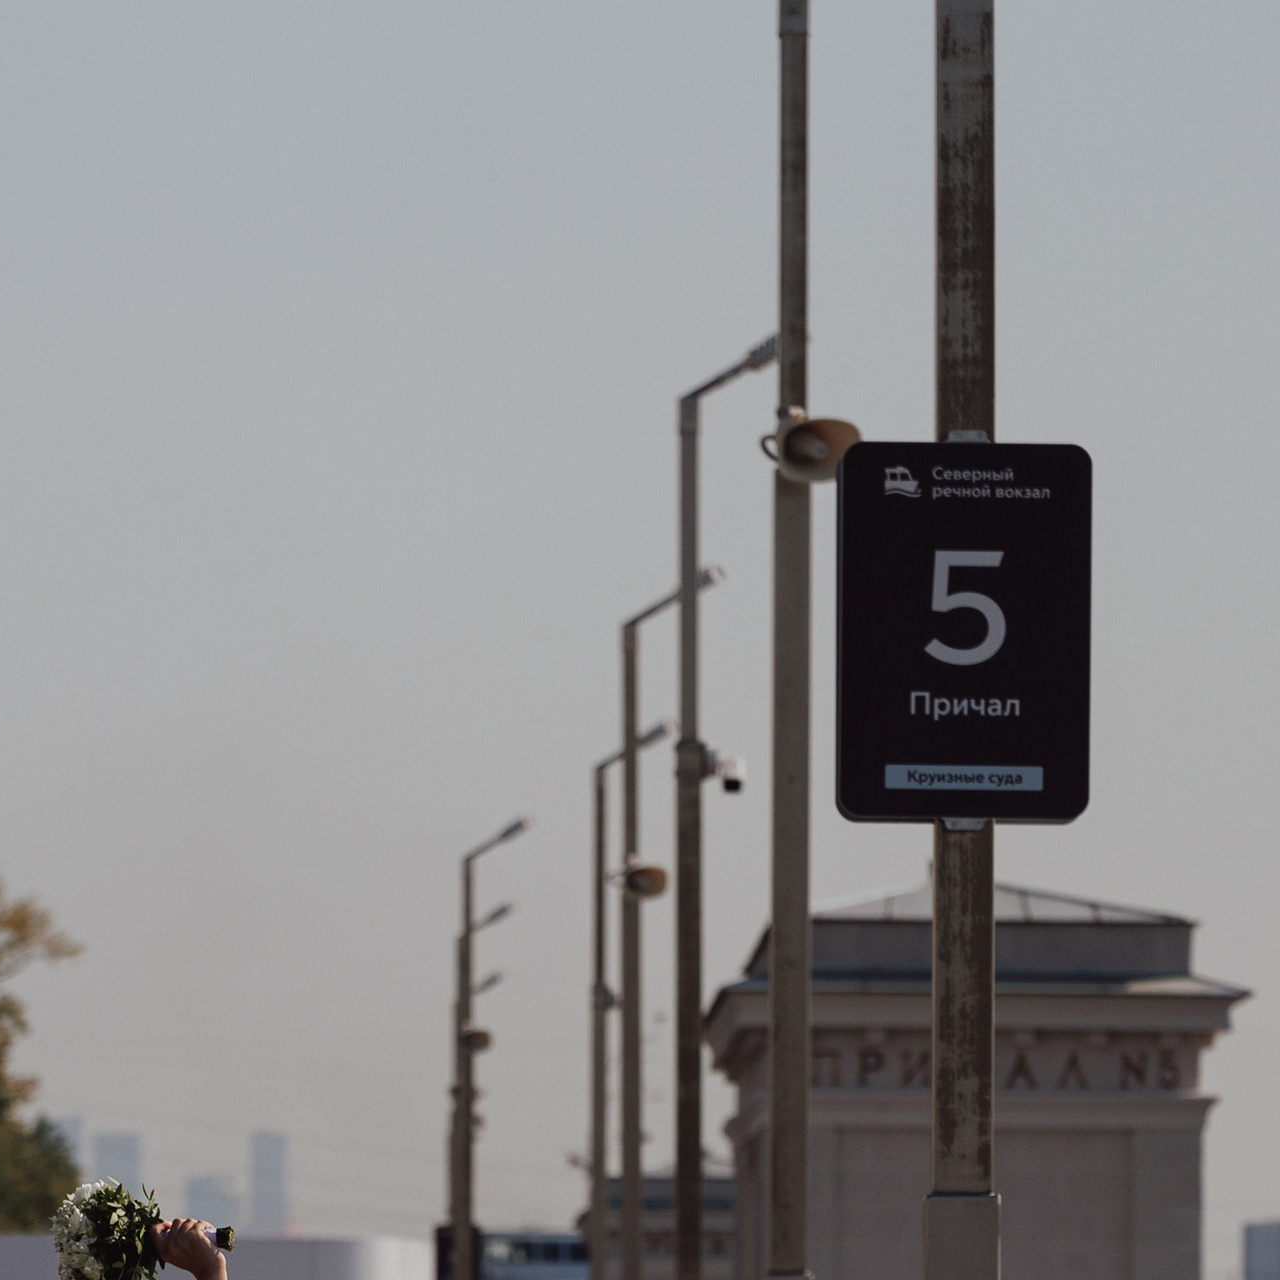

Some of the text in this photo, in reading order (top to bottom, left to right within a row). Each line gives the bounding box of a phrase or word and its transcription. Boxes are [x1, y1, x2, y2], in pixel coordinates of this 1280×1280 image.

[931, 466, 1014, 482] Северный
[931, 484, 1051, 500] речной вокзал
[924, 550, 1007, 665] 5
[910, 691, 1020, 720] Причал
[907, 769, 1023, 787] Круизные суда
[811, 1049, 1090, 1090] ПРИАЛ
